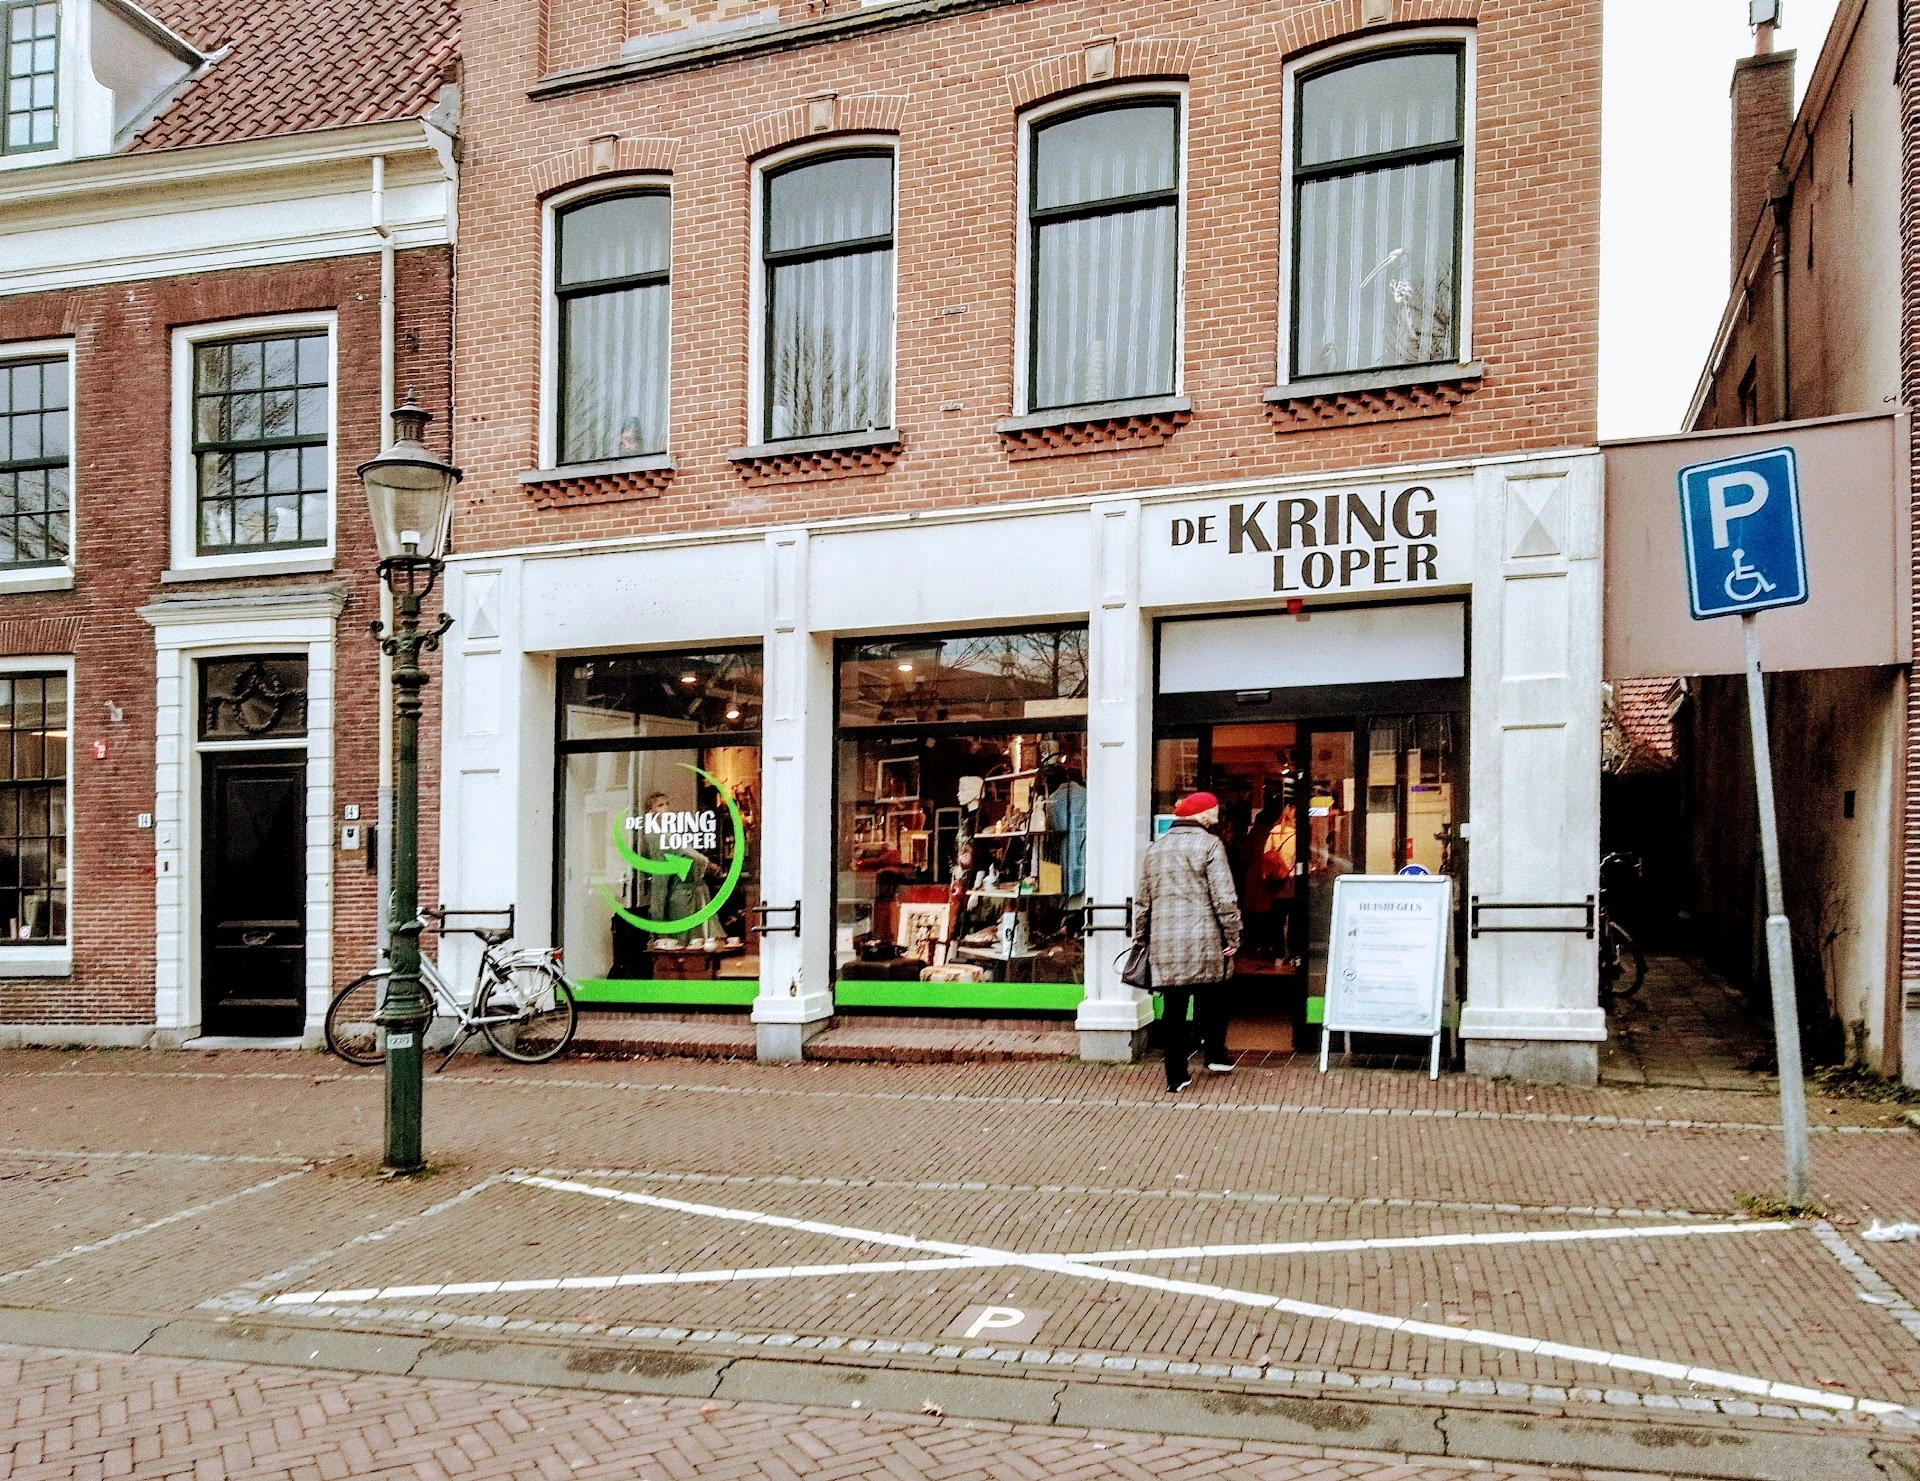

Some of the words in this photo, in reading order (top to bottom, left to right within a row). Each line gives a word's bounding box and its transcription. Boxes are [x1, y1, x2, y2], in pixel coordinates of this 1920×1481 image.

[1170, 514, 1218, 547] DE
[1227, 486, 1438, 555] KRING
[1707, 470, 1770, 550] P
[1272, 543, 1438, 592] LOPER
[625, 816, 644, 830] DE
[644, 810, 717, 834] KRING
[660, 832, 717, 850] LOPER
[963, 1305, 1026, 1339] P
